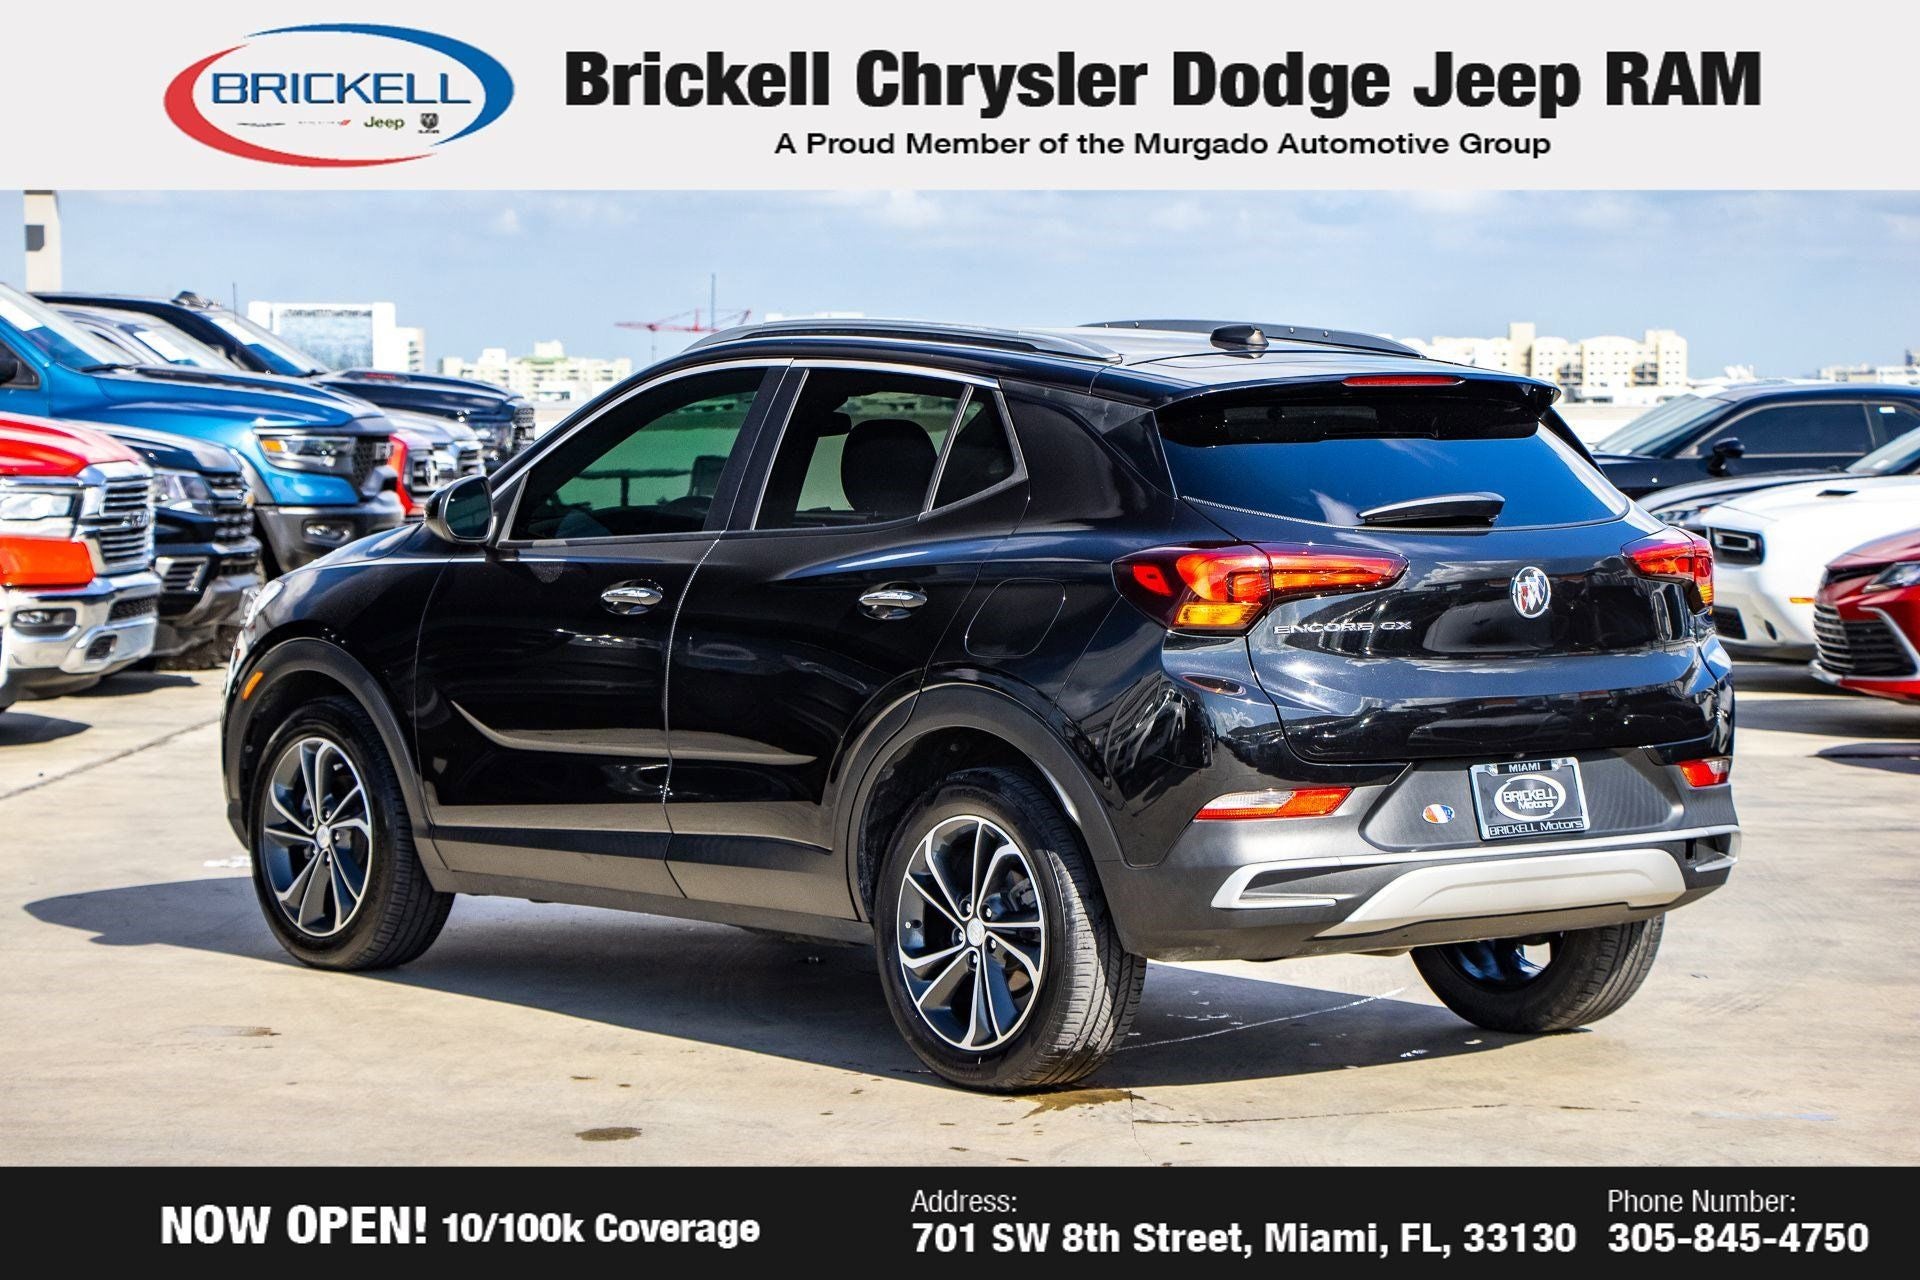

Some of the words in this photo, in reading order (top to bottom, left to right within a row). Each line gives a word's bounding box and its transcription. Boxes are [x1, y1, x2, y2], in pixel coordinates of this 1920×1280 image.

[1273, 622, 1375, 634] ENCORE
[1380, 621, 1412, 630] GX
[1508, 762, 1540, 773] MIAMI
[1503, 788, 1557, 802] BRICKELL
[1518, 800, 1553, 809] Motors
[1489, 823, 1538, 836] BRICKELL
[1540, 820, 1583, 832] Motors
